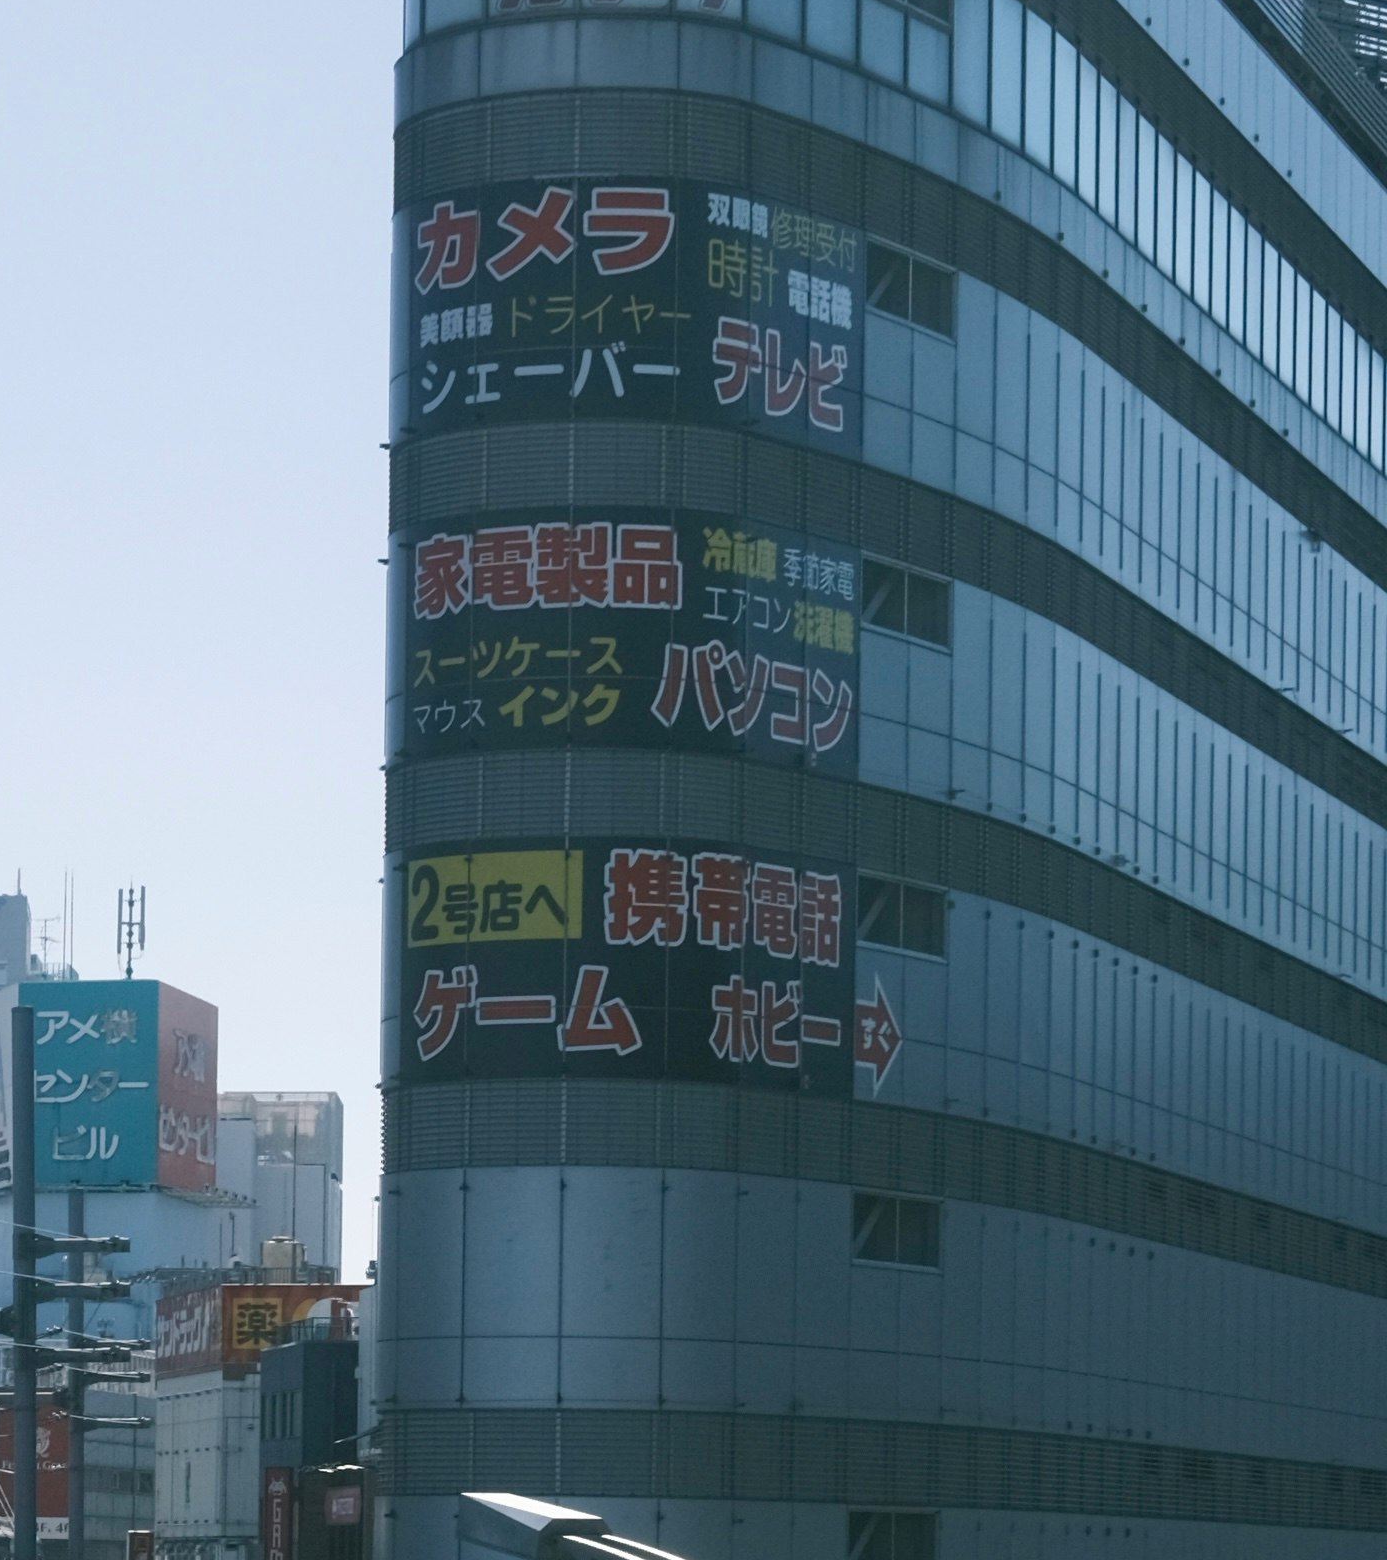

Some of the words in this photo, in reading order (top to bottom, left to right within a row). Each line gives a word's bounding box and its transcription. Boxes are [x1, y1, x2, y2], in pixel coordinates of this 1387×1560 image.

[415, 186, 675, 295] カメラ
[708, 192, 768, 238] 双眼鏡
[770, 206, 857, 273] 修理受付
[708, 239, 779, 307] 時計
[787, 270, 853, 330] 電話機
[511, 294, 692, 338] ドライヤー
[422, 341, 680, 414] シェーバー
[713, 316, 848, 432] テレビ
[414, 522, 682, 620] 家電製品
[702, 527, 777, 583] 冷蔵庫
[783, 548, 855, 601] 季節家電
[702, 587, 792, 635] エアコン
[794, 600, 854, 655] 洗濯機
[414, 635, 623, 688] スーツケース
[413, 699, 485, 734] マウス
[499, 684, 620, 727] インク
[651, 640, 852, 753] パソコン
[412, 865, 568, 942] 2号店へ
[604, 848, 841, 967] 携帯電話
[36, 1009, 138, 1045] アメ横
[413, 964, 642, 1062] ゲーム
[710, 974, 841, 1068] ホビー
[34, 1068, 150, 1104] センター
[53, 1125, 120, 1161] ビル
[236, 1301, 279, 1345] 薬
